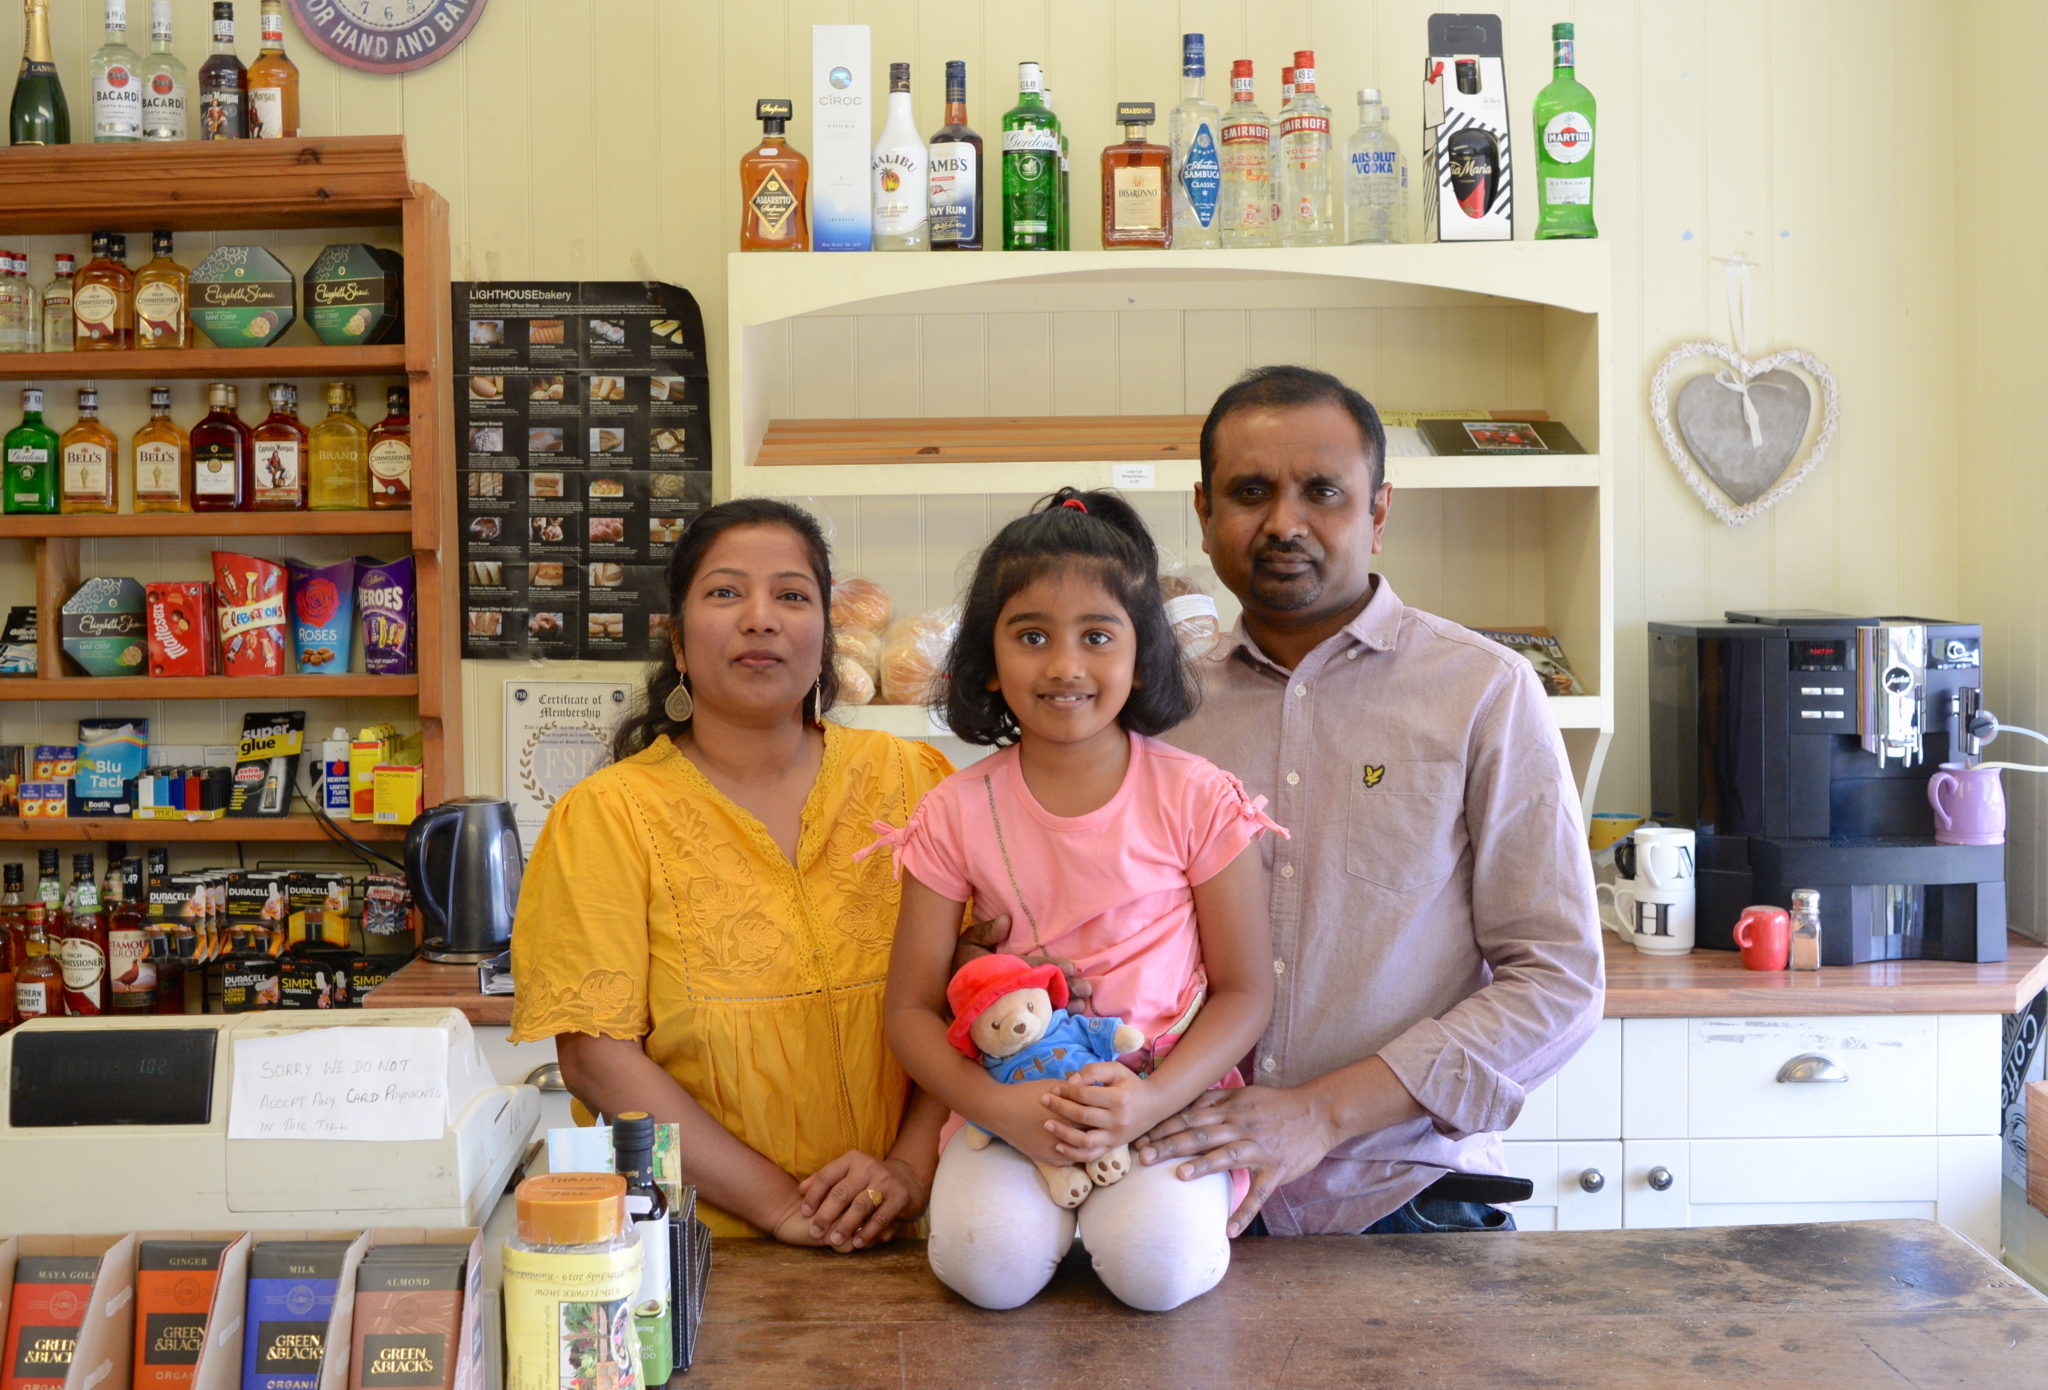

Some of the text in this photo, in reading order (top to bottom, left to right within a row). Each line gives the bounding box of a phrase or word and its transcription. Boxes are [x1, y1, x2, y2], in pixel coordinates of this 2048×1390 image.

[305, 0, 336, 27] OR
[330, 20, 388, 58] HAND
[395, 25, 436, 59] AND
[1280, 117, 1328, 134] SMIRNOFF
[1223, 125, 1270, 140] SMIRNOFF
[1548, 132, 1589, 142] MARTINI
[930, 156, 968, 172] AMB'S
[1351, 151, 1397, 164] ABSOLUT
[1356, 162, 1393, 175] VODKA
[1460, 159, 1492, 177] Maria
[1191, 181, 1216, 189] CLASSIC
[755, 195, 791, 205] AMARETTO
[1118, 189, 1158, 198] DISARONNO
[945, 205, 967, 215] RUM
[205, 284, 246, 306] Elizabeth
[314, 283, 346, 305] Elizabeth
[469, 289, 572, 302] LIGHTHOUSEbakery
[67, 451, 102, 463] BELL'S
[139, 450, 175, 463] BELL'S
[358, 585, 404, 612] HEROES
[79, 615, 120, 635] Elizabeth
[153, 603, 189, 660] Maltesers
[298, 628, 338, 642] ROSES
[1886, 674, 1911, 687] jura
[516, 691, 527, 699] FSB
[538, 694, 603, 705] Certificate of
[539, 707, 601, 719] Membership
[242, 724, 290, 742] super
[241, 739, 276, 756] glue
[96, 760, 122, 773] Blu
[90, 775, 126, 788] Tack
[88, 801, 111, 809] Bostik
[150, 892, 190, 901] DURACELL
[229, 888, 269, 896] DURACELL
[290, 886, 329, 895] DURACELL
[112, 950, 142, 958] GROU
[62, 959, 104, 967] MISSIONER
[224, 974, 267, 984] DURACELL
[2001, 1014, 2029, 1110] Coffe
[260, 1059, 412, 1079] SORRY WE DO NOT
[259, 1093, 306, 1110] ACCEPT
[346, 1088, 380, 1104] CARD
[259, 1119, 349, 1132] IN THIS TILL
[169, 1257, 208, 1266] GINGER
[38, 1271, 66, 1280] MAYA
[288, 1265, 316, 1274] MILK
[385, 1277, 431, 1287] ALMOND
[562, 1273, 584, 1281] 2019
[534, 1288, 599, 1298] FLOWER SHOW
[163, 1326, 206, 1339] GREEN
[633, 1325, 655, 1334] pring
[34, 1338, 78, 1351] GREEN
[275, 1334, 321, 1347] GREEN
[266, 1345, 325, 1360] &BLACK'S
[380, 1347, 427, 1361] GREEN
[371, 1358, 434, 1374] &BLACK'S
[156, 1371, 196, 1380] ORGAN
[267, 1380, 318, 1390] ORGANI
